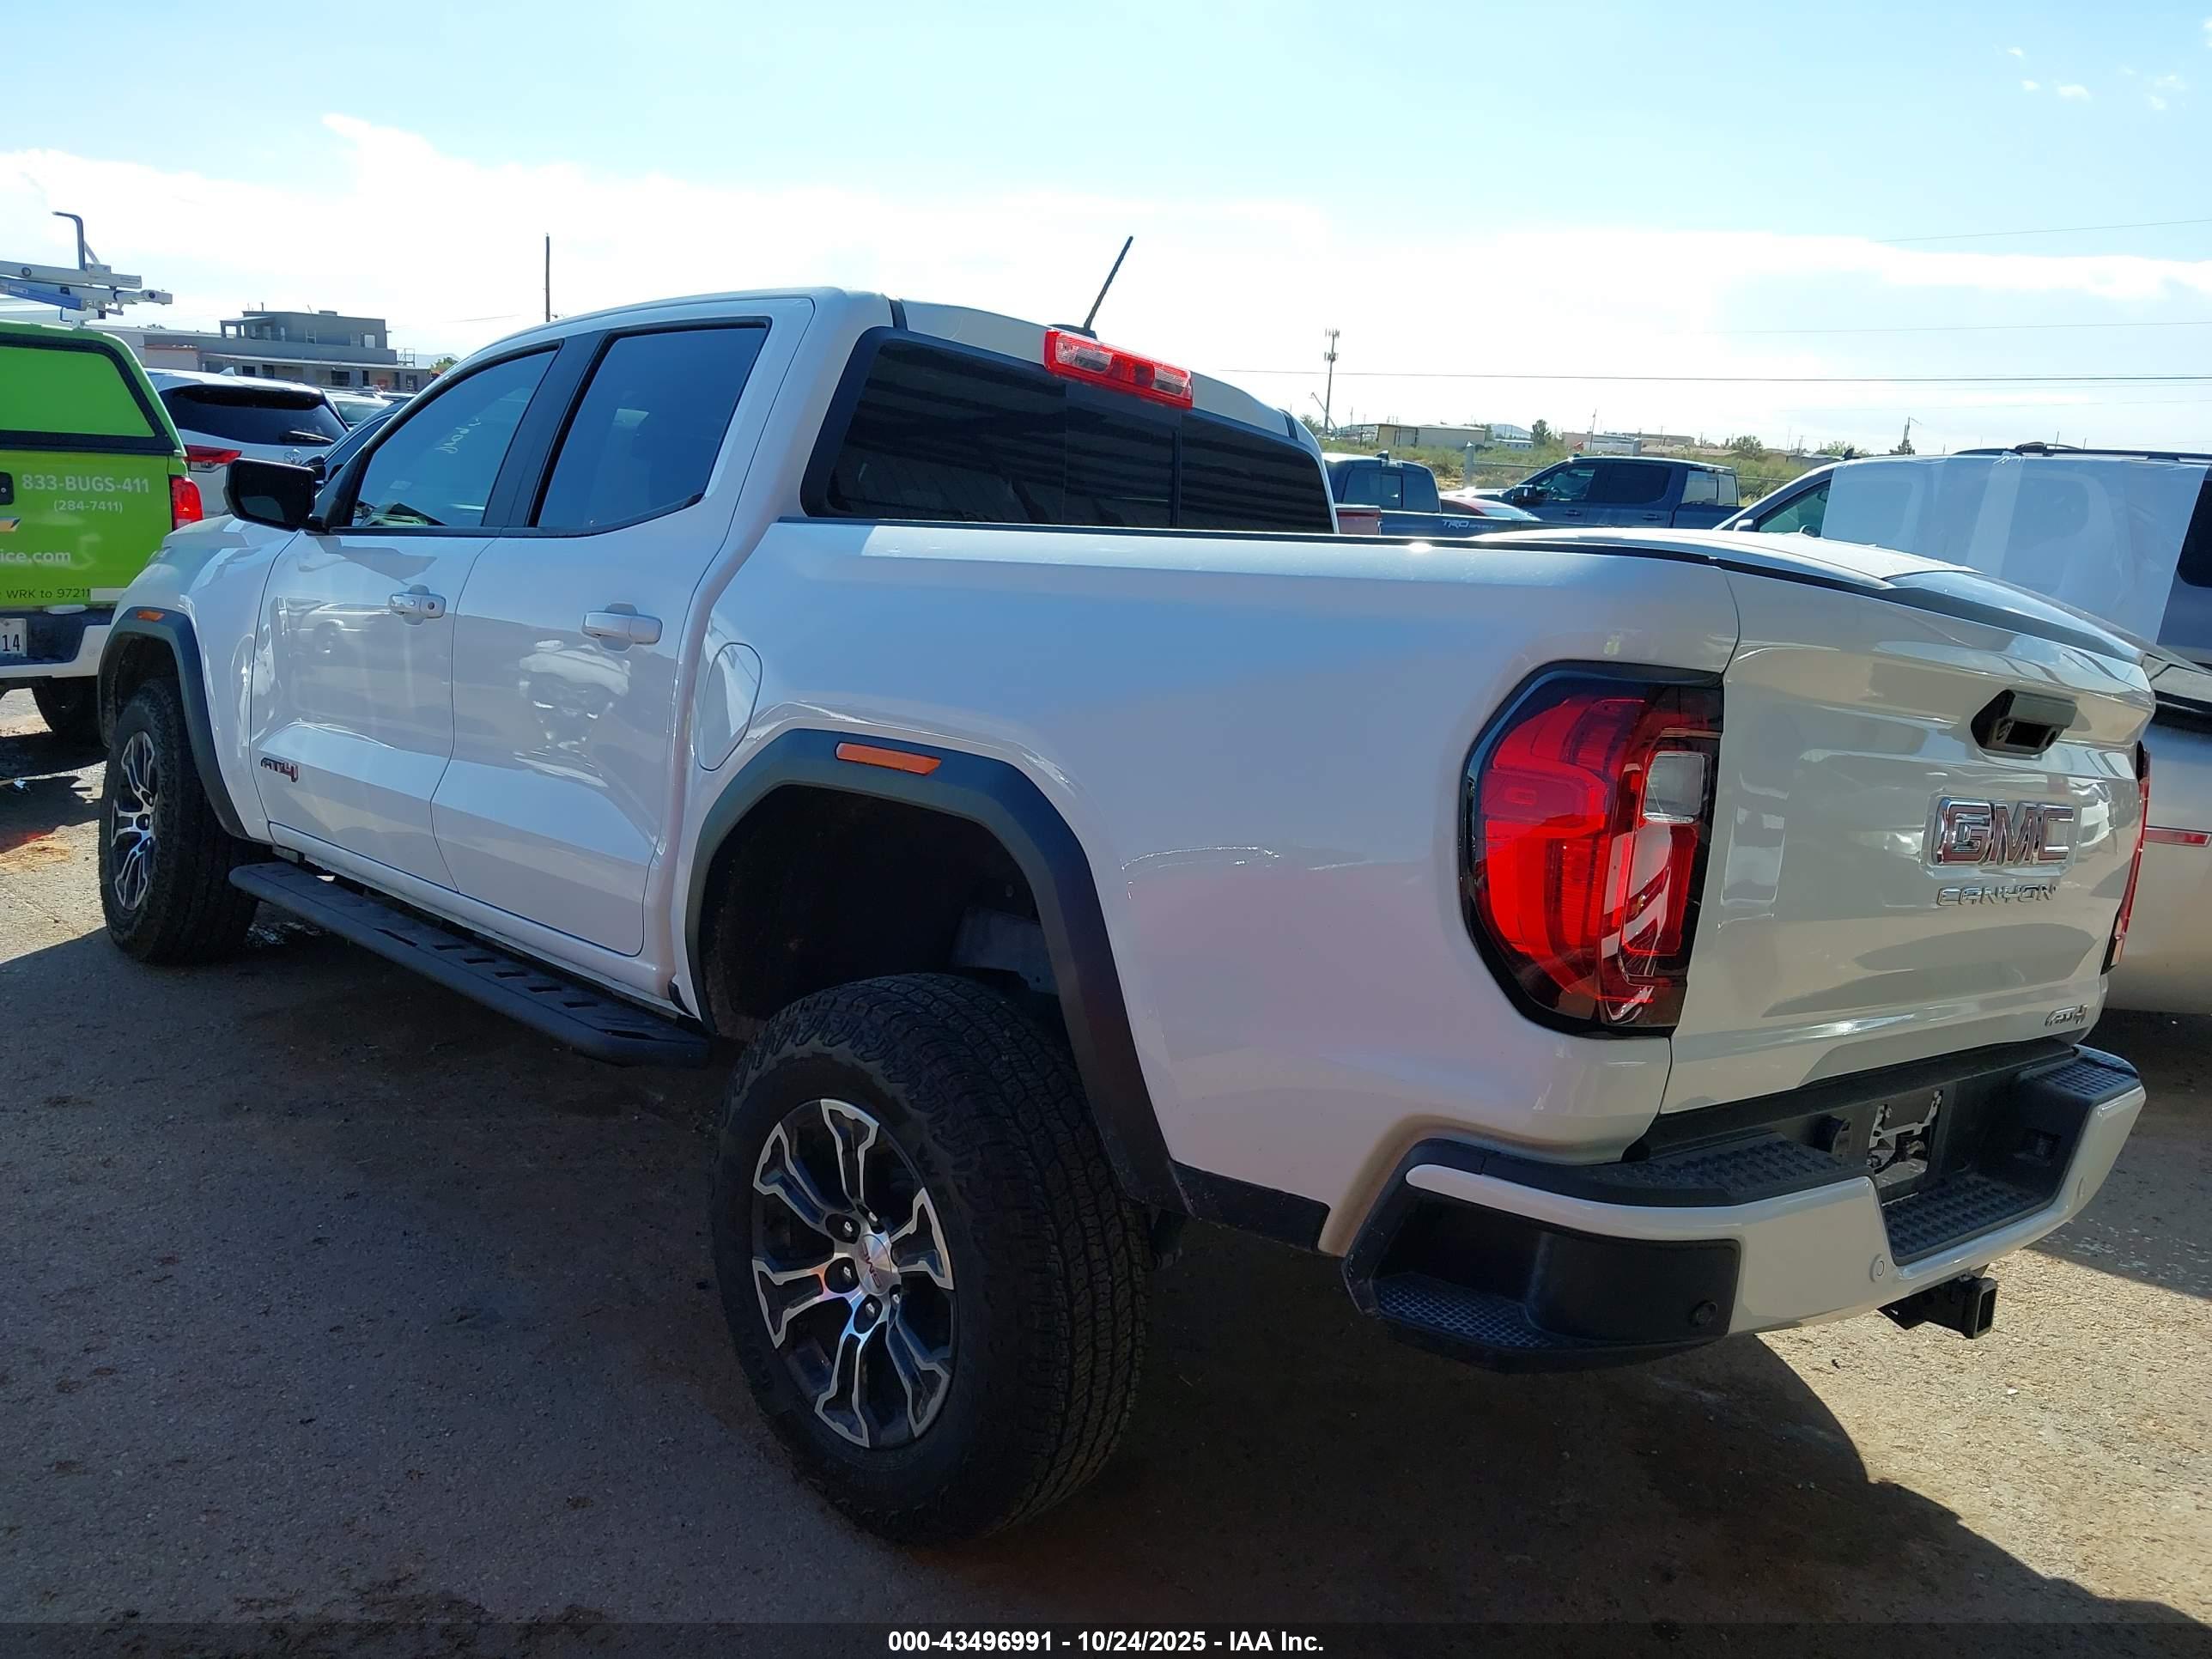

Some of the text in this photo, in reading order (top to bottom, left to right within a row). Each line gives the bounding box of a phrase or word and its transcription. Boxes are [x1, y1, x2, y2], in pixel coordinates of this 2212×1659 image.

[21, 474, 149, 493] 833-BUGS-411
[53, 500, 124, 514] (284-7411)
[1443, 519, 1470, 529] TRD
[7, 589, 35, 599] WRK
[40, 590, 52, 599] to
[1933, 797, 2075, 866] GMC
[1937, 885, 2057, 906] CANYON
